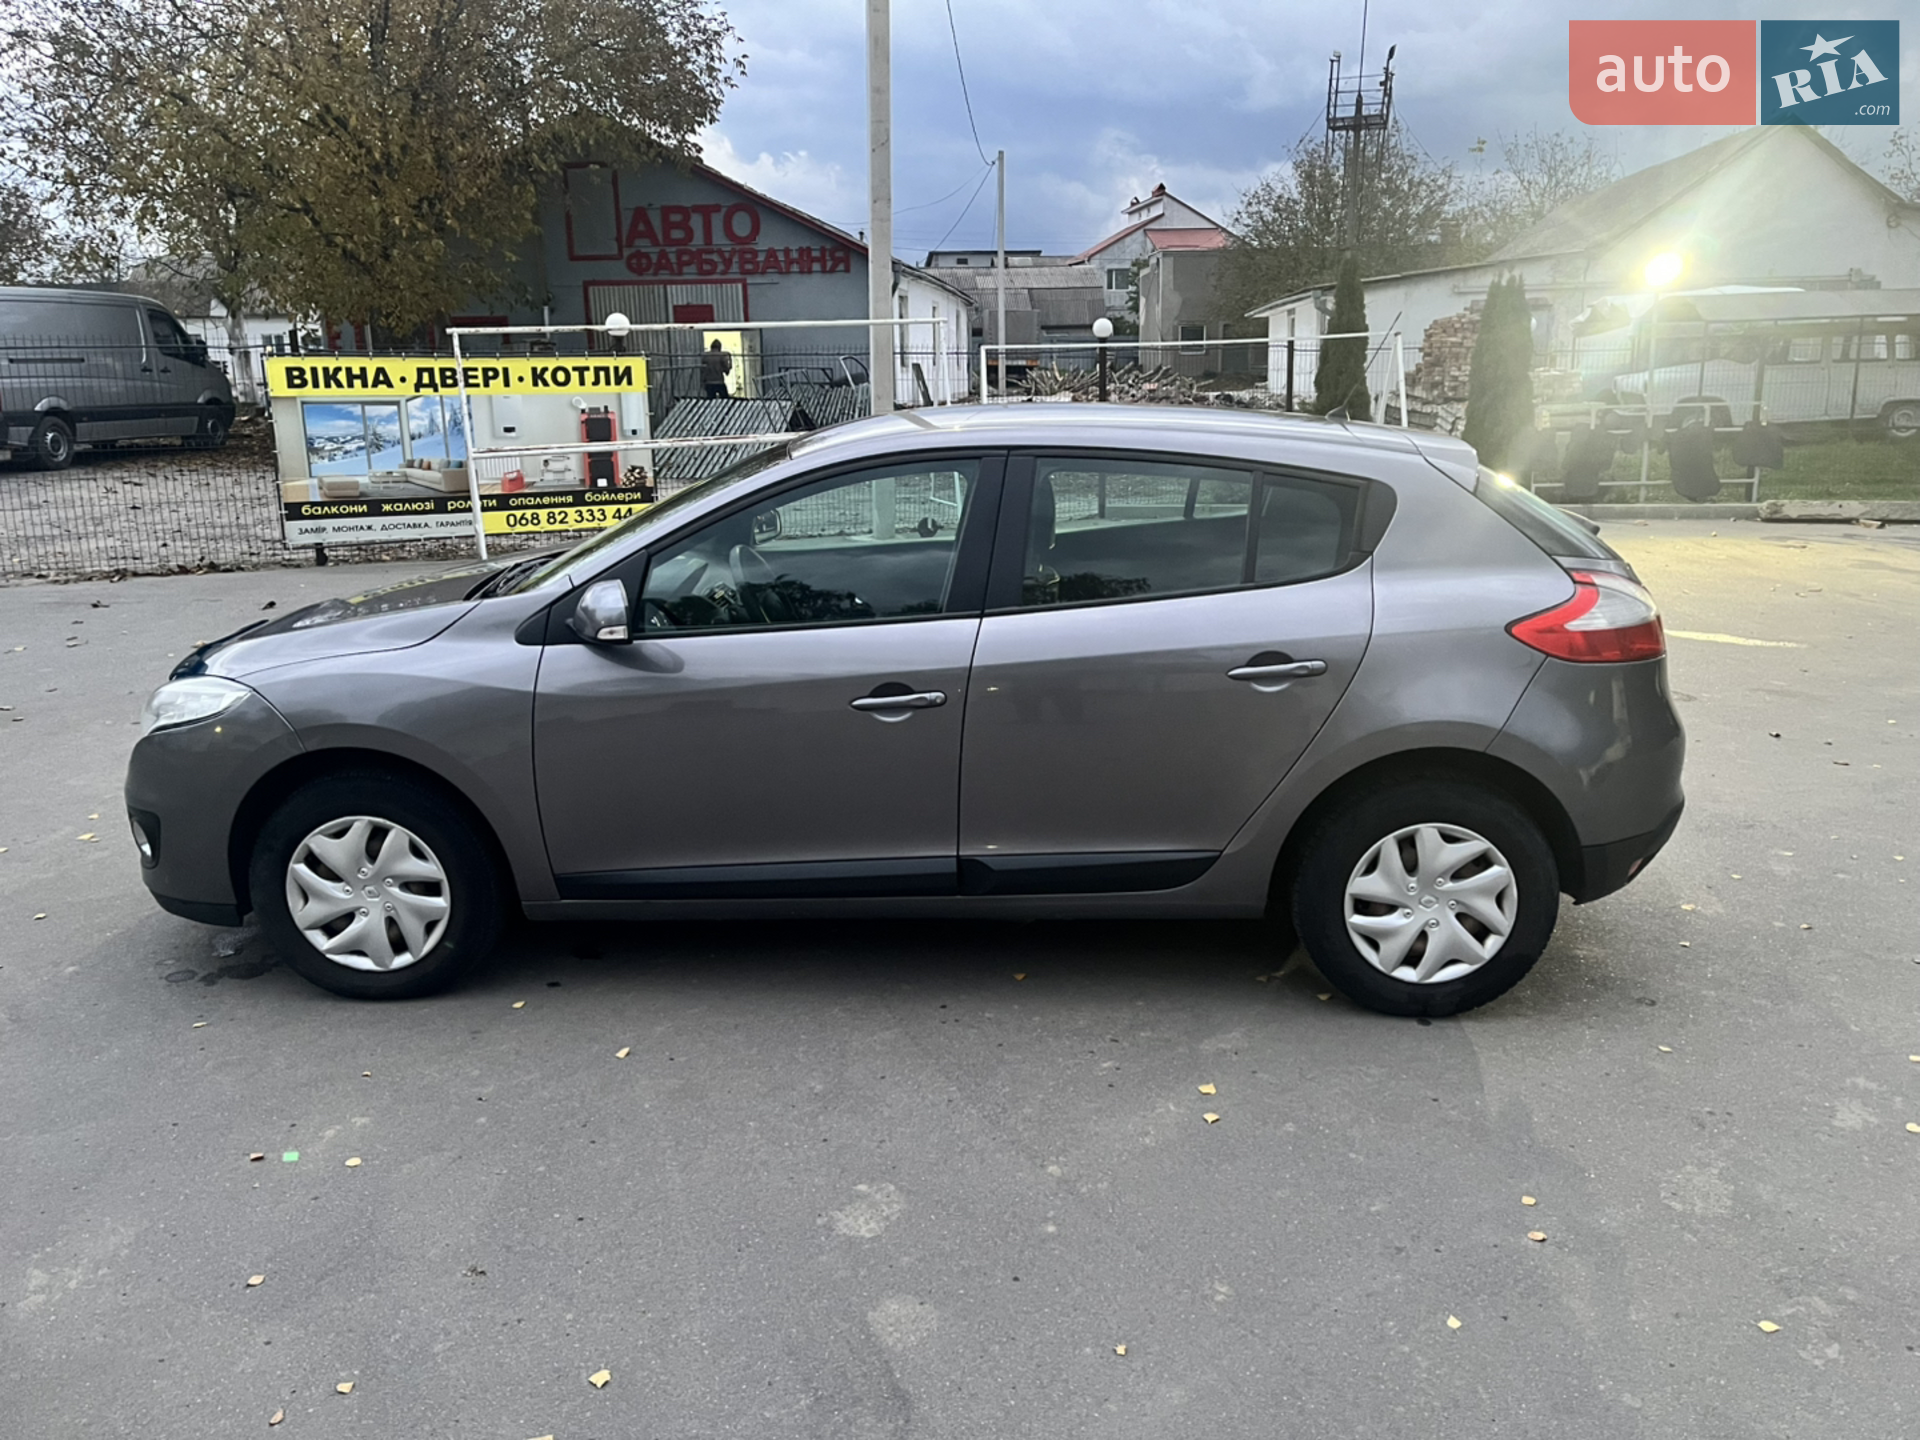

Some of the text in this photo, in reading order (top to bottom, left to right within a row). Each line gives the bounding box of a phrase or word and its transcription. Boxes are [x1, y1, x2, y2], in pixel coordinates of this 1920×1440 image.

[625, 204, 761, 247] АВТО
[625, 246, 851, 276] ФАРБУВАННЯ
[285, 365, 633, 393] ВІКНА ДВЕРІ КОТЛИ
[301, 491, 641, 516] балкони жалюзі ролти опалення бойлери
[506, 513, 541, 528] 068
[546, 511, 569, 525] 82
[573, 508, 607, 523] 333
